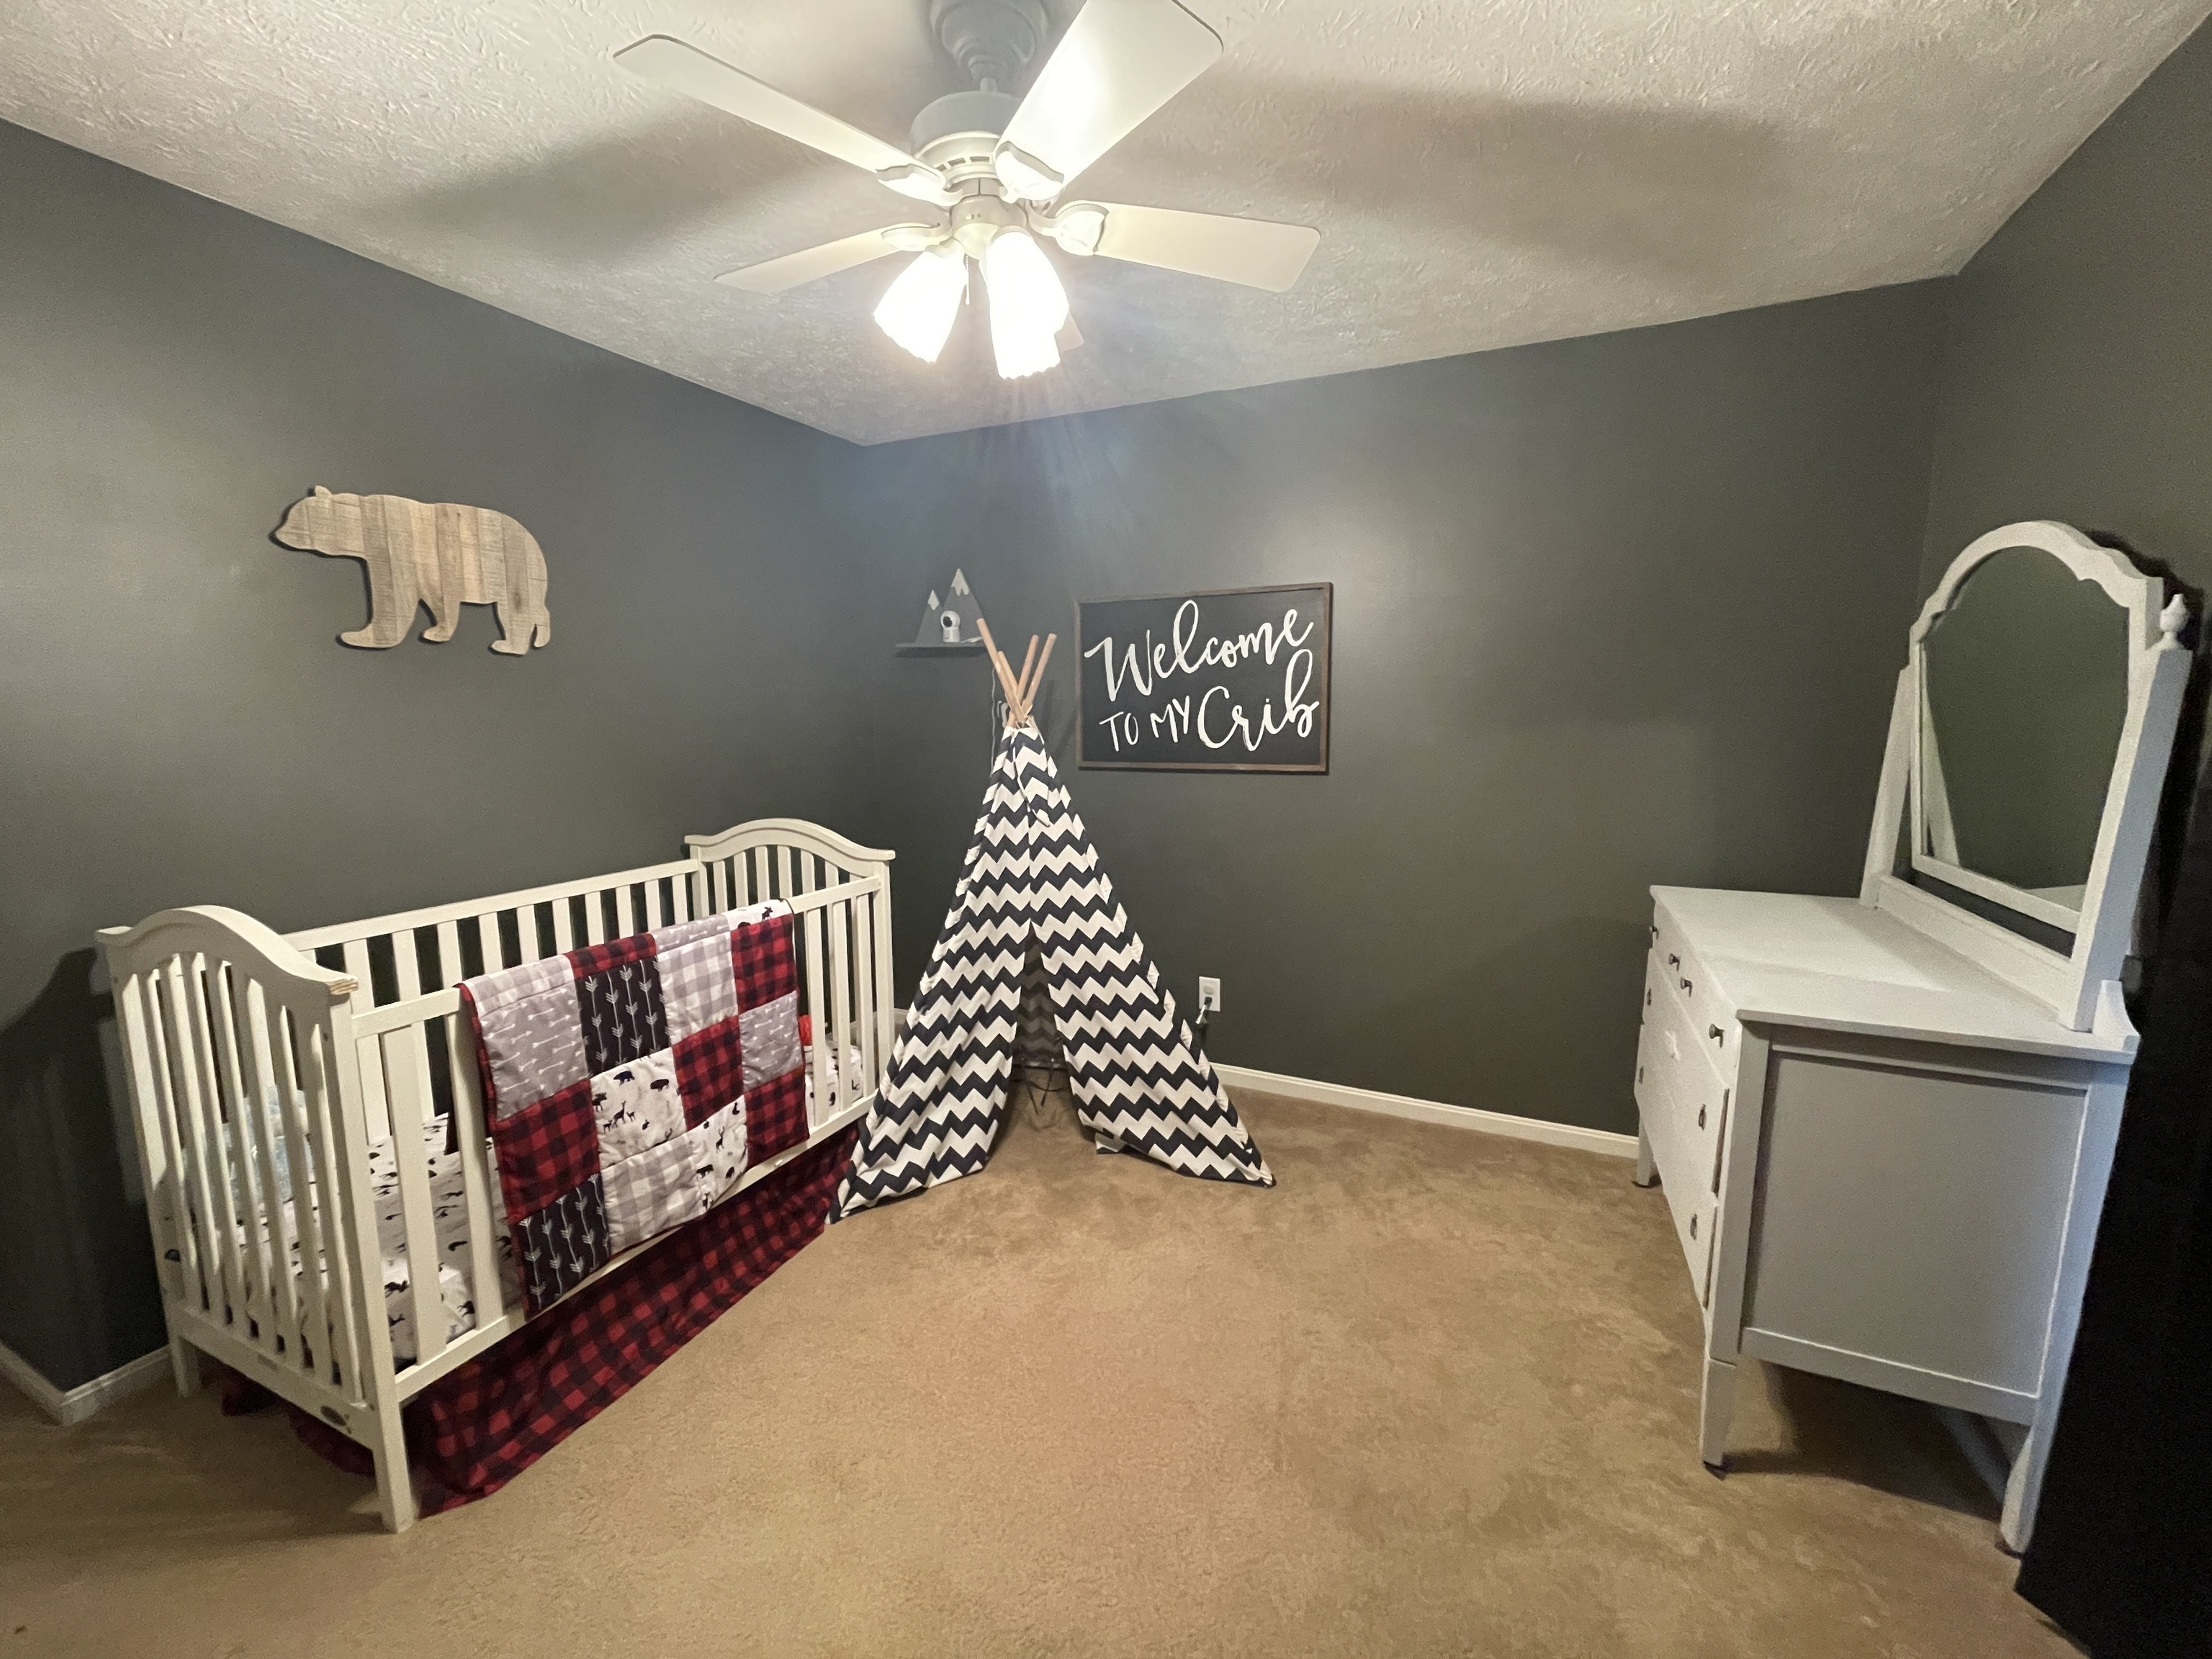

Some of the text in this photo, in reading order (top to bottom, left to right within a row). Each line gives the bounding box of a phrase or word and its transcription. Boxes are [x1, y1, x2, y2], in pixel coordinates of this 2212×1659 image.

[1084, 599, 1315, 702] Welcome
[1099, 648, 1320, 752] TO MY Crib
